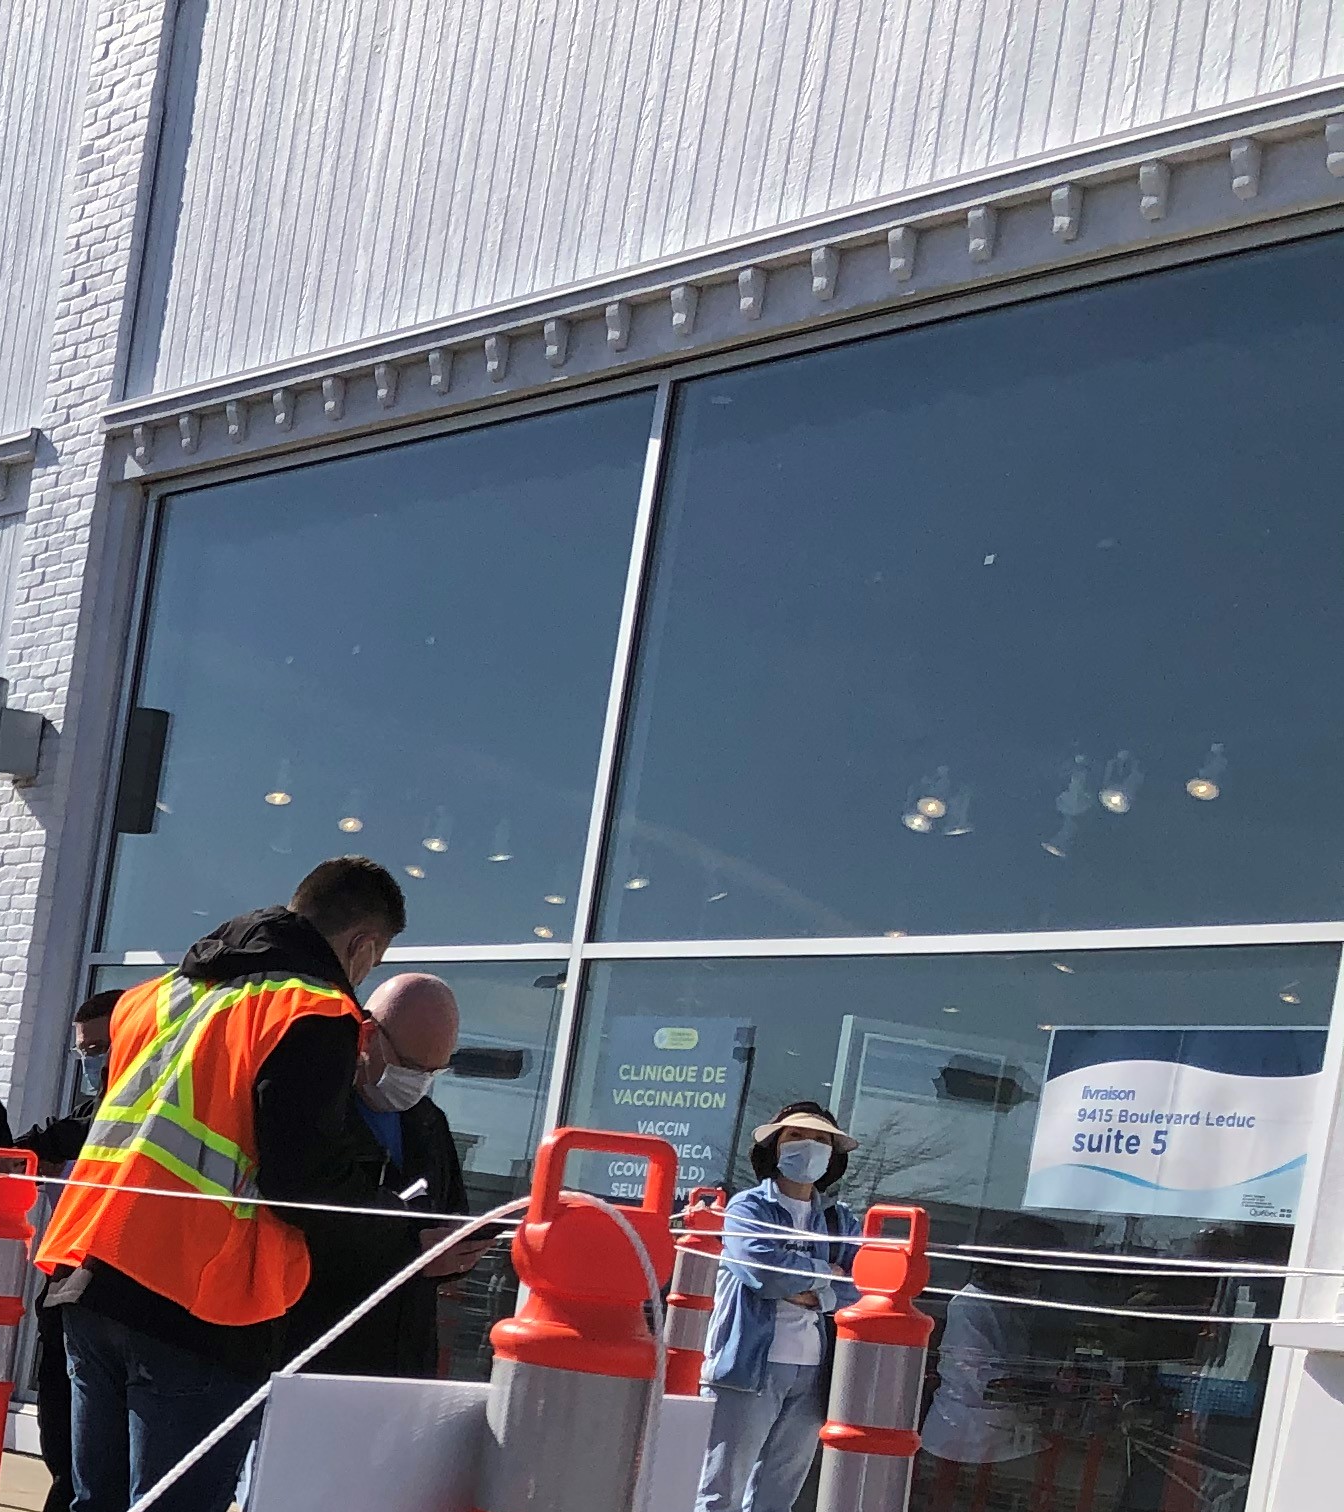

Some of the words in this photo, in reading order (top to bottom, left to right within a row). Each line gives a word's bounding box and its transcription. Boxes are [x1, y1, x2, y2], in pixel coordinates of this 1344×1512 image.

[619, 1064, 698, 1083] CLINIQUE
[703, 1066, 727, 1084] DE
[612, 1089, 726, 1108] VACCINATION
[1081, 1085, 1136, 1101] livraison
[1077, 1108, 1113, 1124] 9415
[1118, 1108, 1200, 1126] Boulevard
[1205, 1112, 1255, 1129] Leduc
[637, 1121, 690, 1136] VACCIN
[1072, 1128, 1141, 1155] suite
[1150, 1130, 1169, 1156] 5
